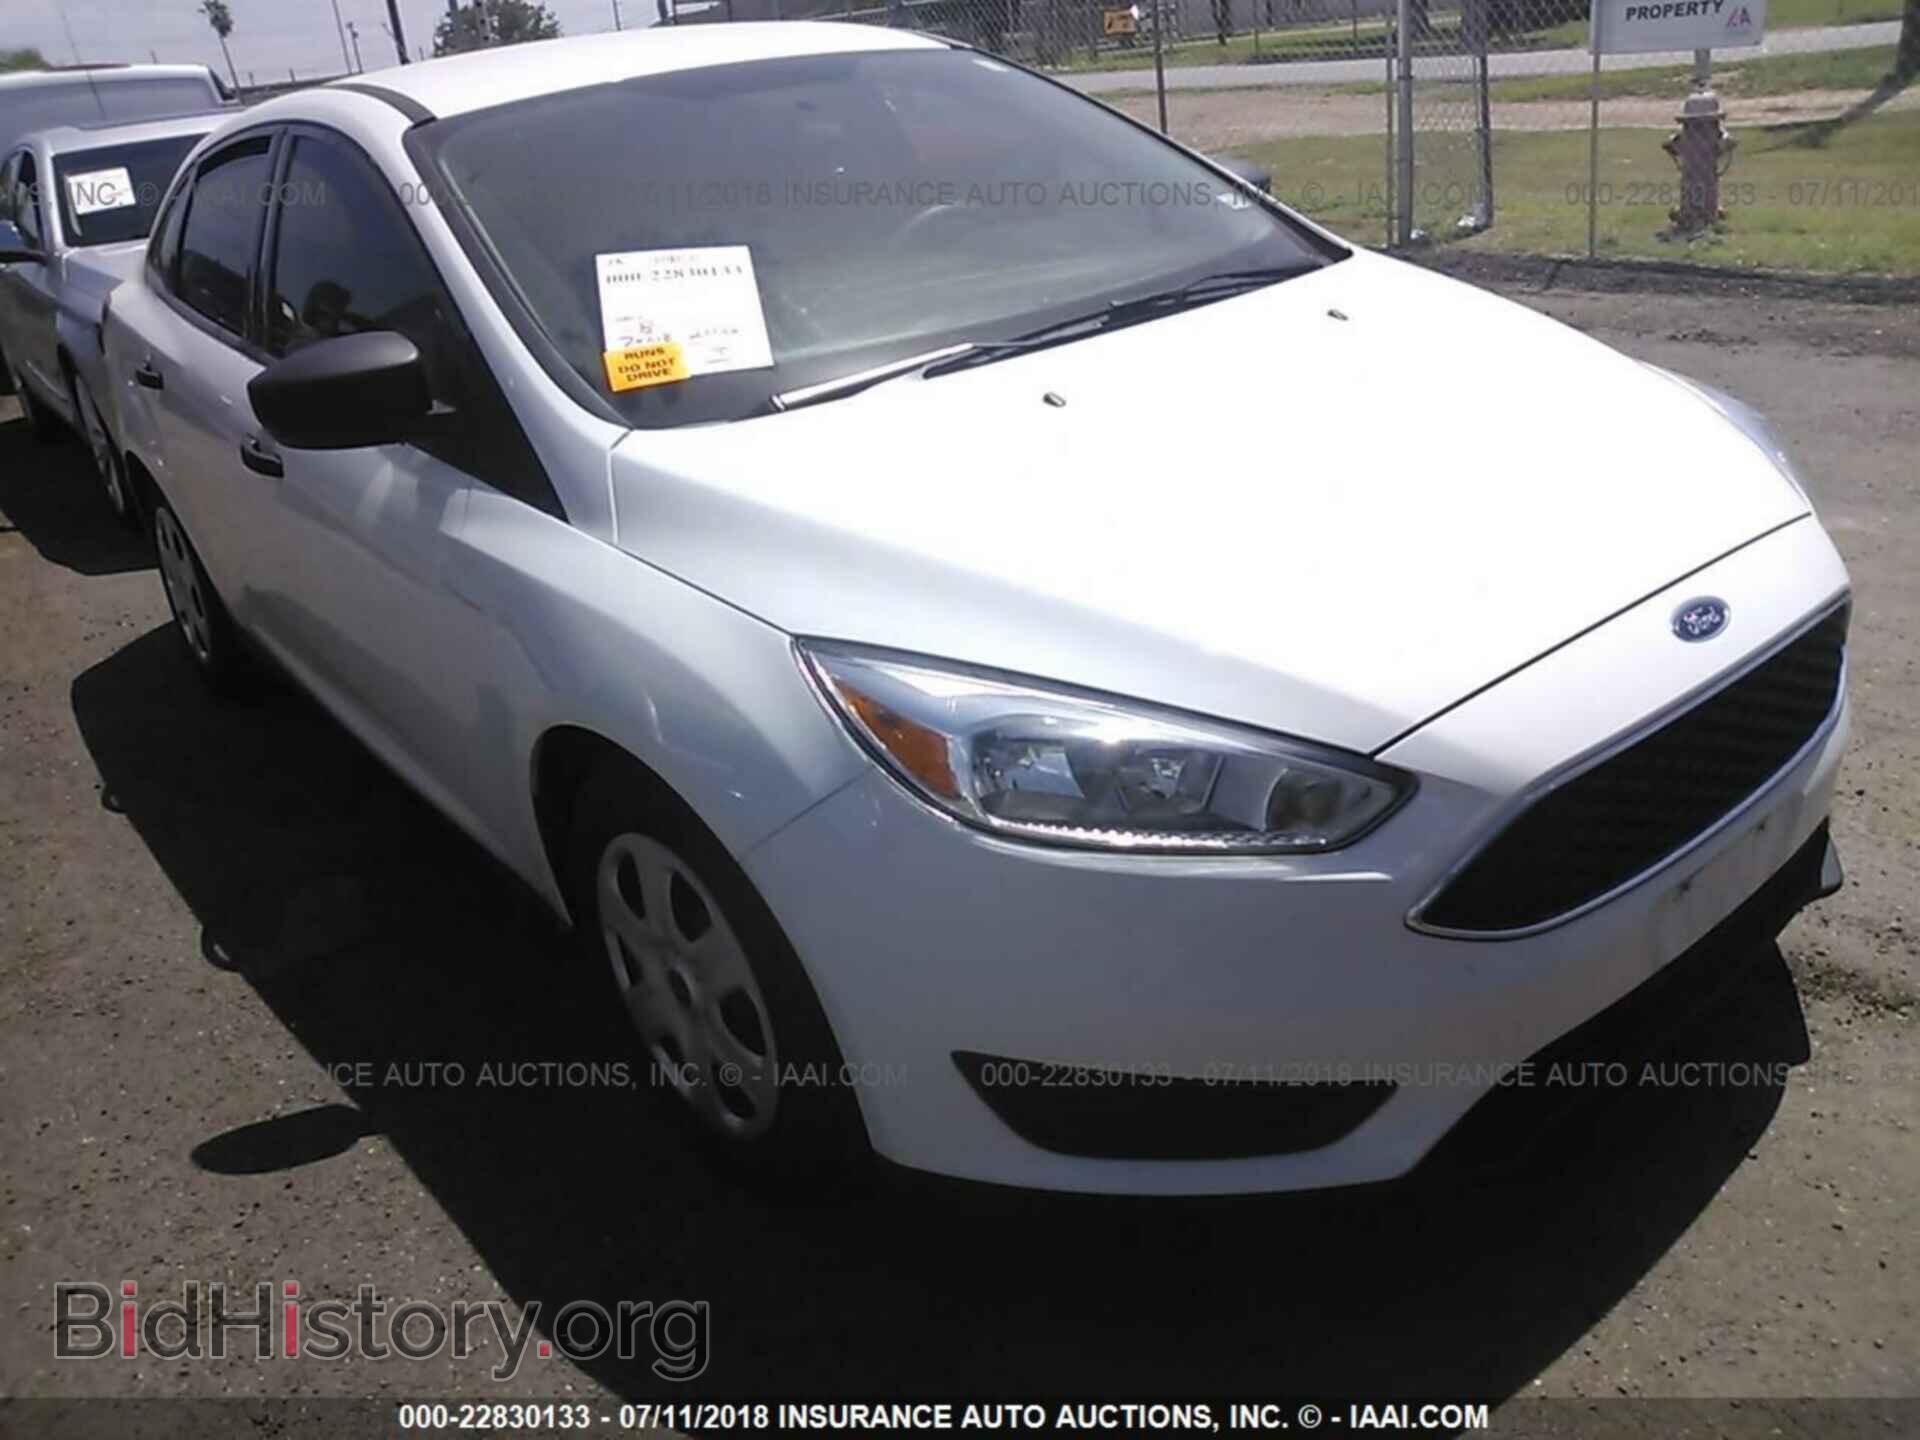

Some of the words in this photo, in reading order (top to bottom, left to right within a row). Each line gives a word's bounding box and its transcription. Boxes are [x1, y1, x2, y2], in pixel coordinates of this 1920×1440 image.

[1625, 0, 1725, 21] PROPERTY
[624, 347, 665, 360] RUNS
[617, 363, 641, 374] DO
[645, 356, 676, 370] NOT
[626, 367, 670, 382] DRIVE
